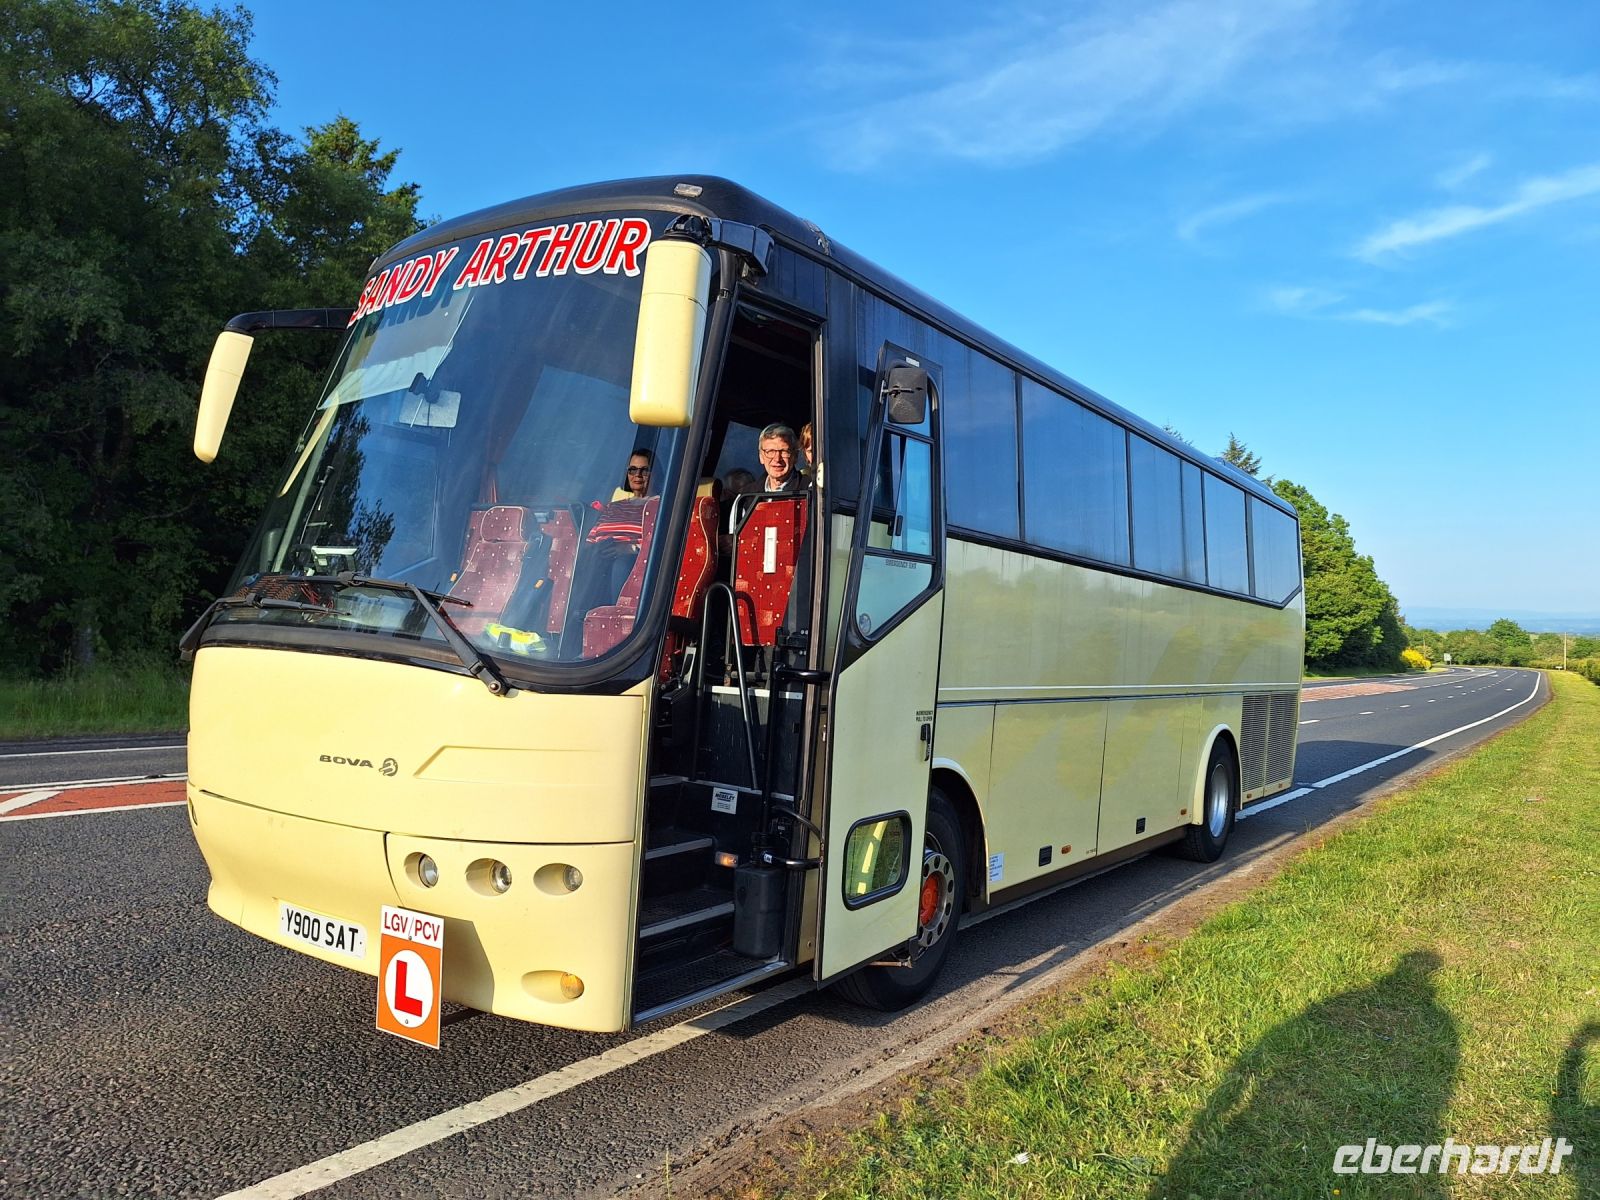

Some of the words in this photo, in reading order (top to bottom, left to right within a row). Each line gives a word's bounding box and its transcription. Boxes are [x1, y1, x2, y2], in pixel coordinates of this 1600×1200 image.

[346, 246, 459, 329] SANDY
[453, 217, 651, 291] ARTHUR
[319, 754, 374, 768] BOVA
[286, 908, 321, 942] Y900
[325, 922, 359, 952] SAT
[394, 959, 423, 1018] L
